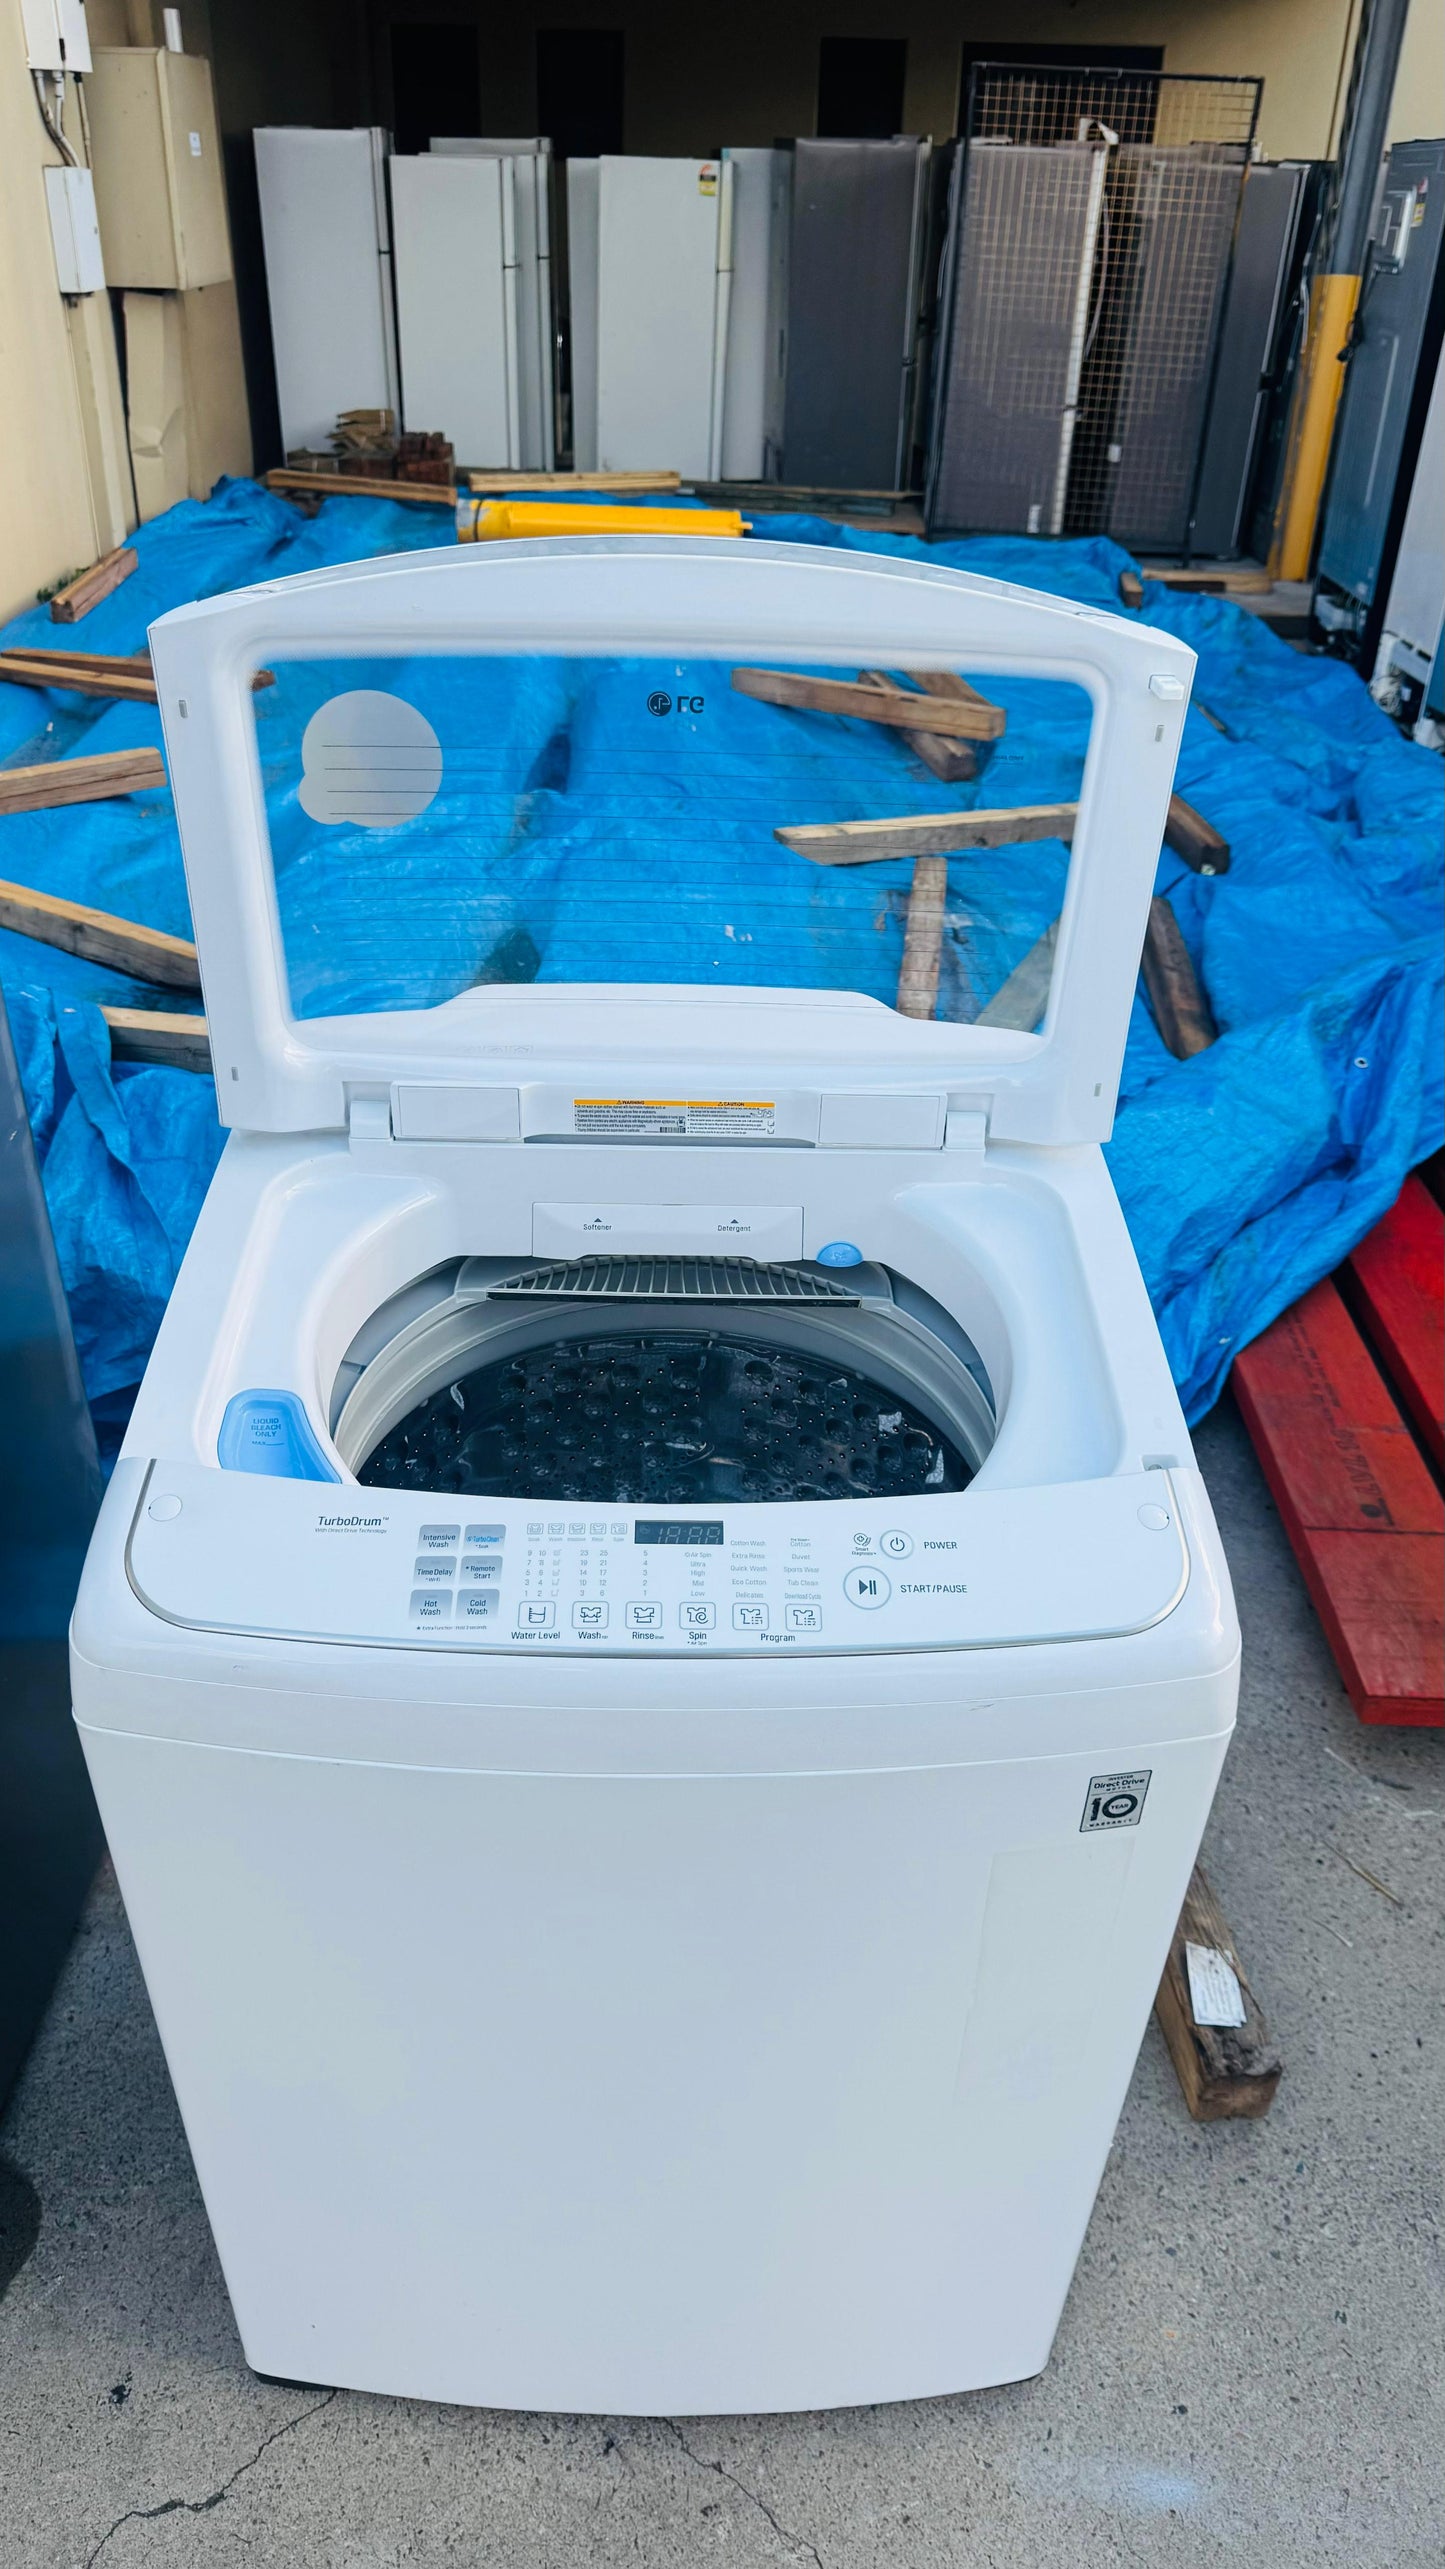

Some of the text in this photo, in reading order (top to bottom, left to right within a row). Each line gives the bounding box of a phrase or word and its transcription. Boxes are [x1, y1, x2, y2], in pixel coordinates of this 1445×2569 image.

[717, 1225, 751, 1233] Detergent
[923, 1541, 958, 1549] POWER
[434, 1569, 453, 1577] Delay
[900, 1585, 968, 1593] START/PAUSE
[424, 1600, 438, 1608] Hot
[419, 1608, 441, 1616] Wash
[511, 1631, 561, 1640] Water Level
[578, 1631, 601, 1640] Wash
[632, 1631, 655, 1640] Rinse
[688, 1631, 707, 1641] Spin
[760, 1633, 796, 1642] Program
[1093, 1778, 1145, 1789] Direct Drive
[1089, 1793, 1138, 1821] 10
